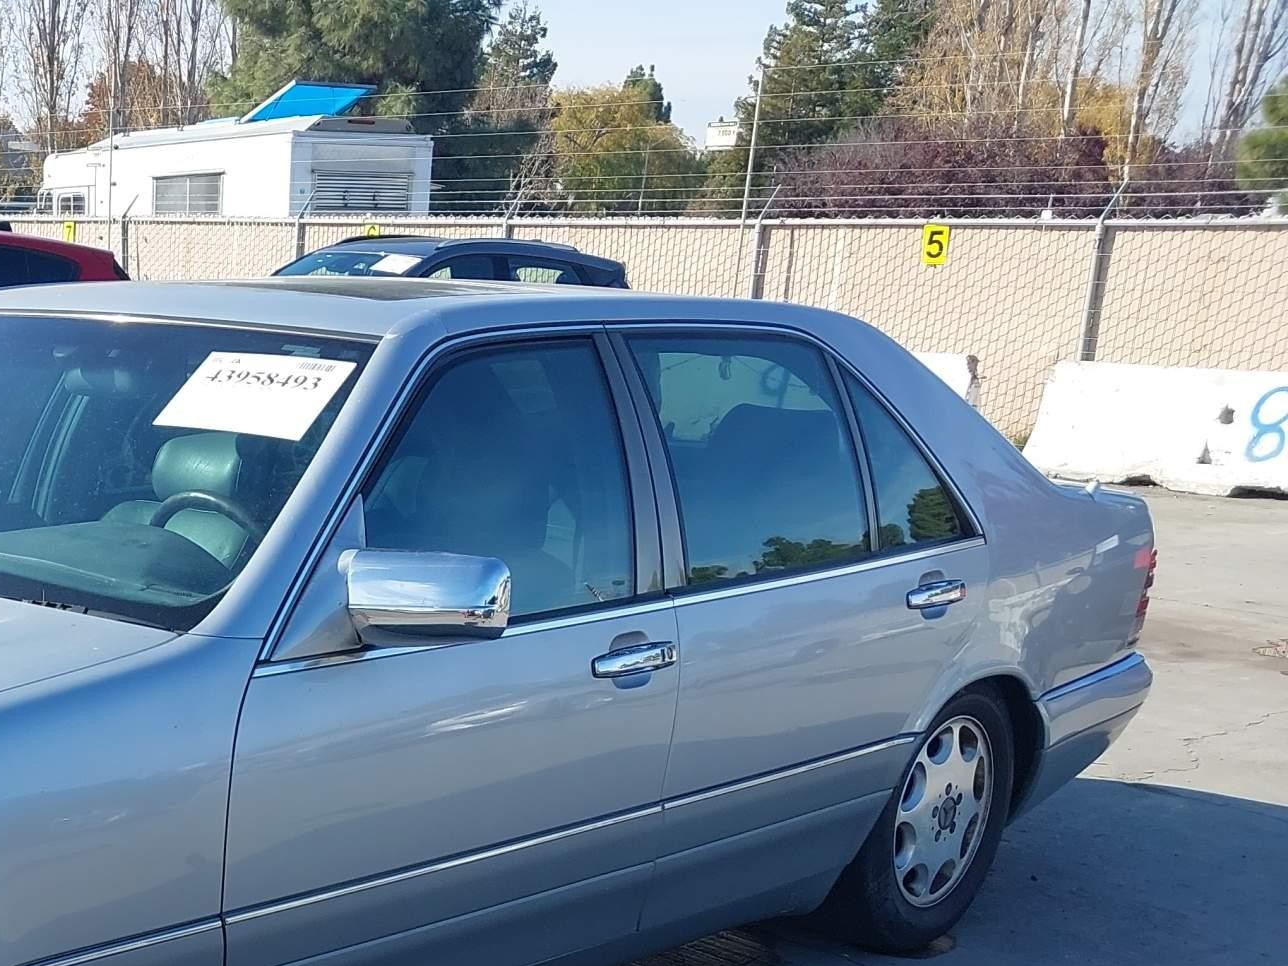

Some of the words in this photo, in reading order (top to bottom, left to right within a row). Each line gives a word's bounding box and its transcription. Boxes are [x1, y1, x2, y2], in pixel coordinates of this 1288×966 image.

[66, 225, 72, 241] 7
[926, 231, 944, 258] 5
[205, 369, 322, 390] 43958493
[1245, 386, 1288, 462] 8
